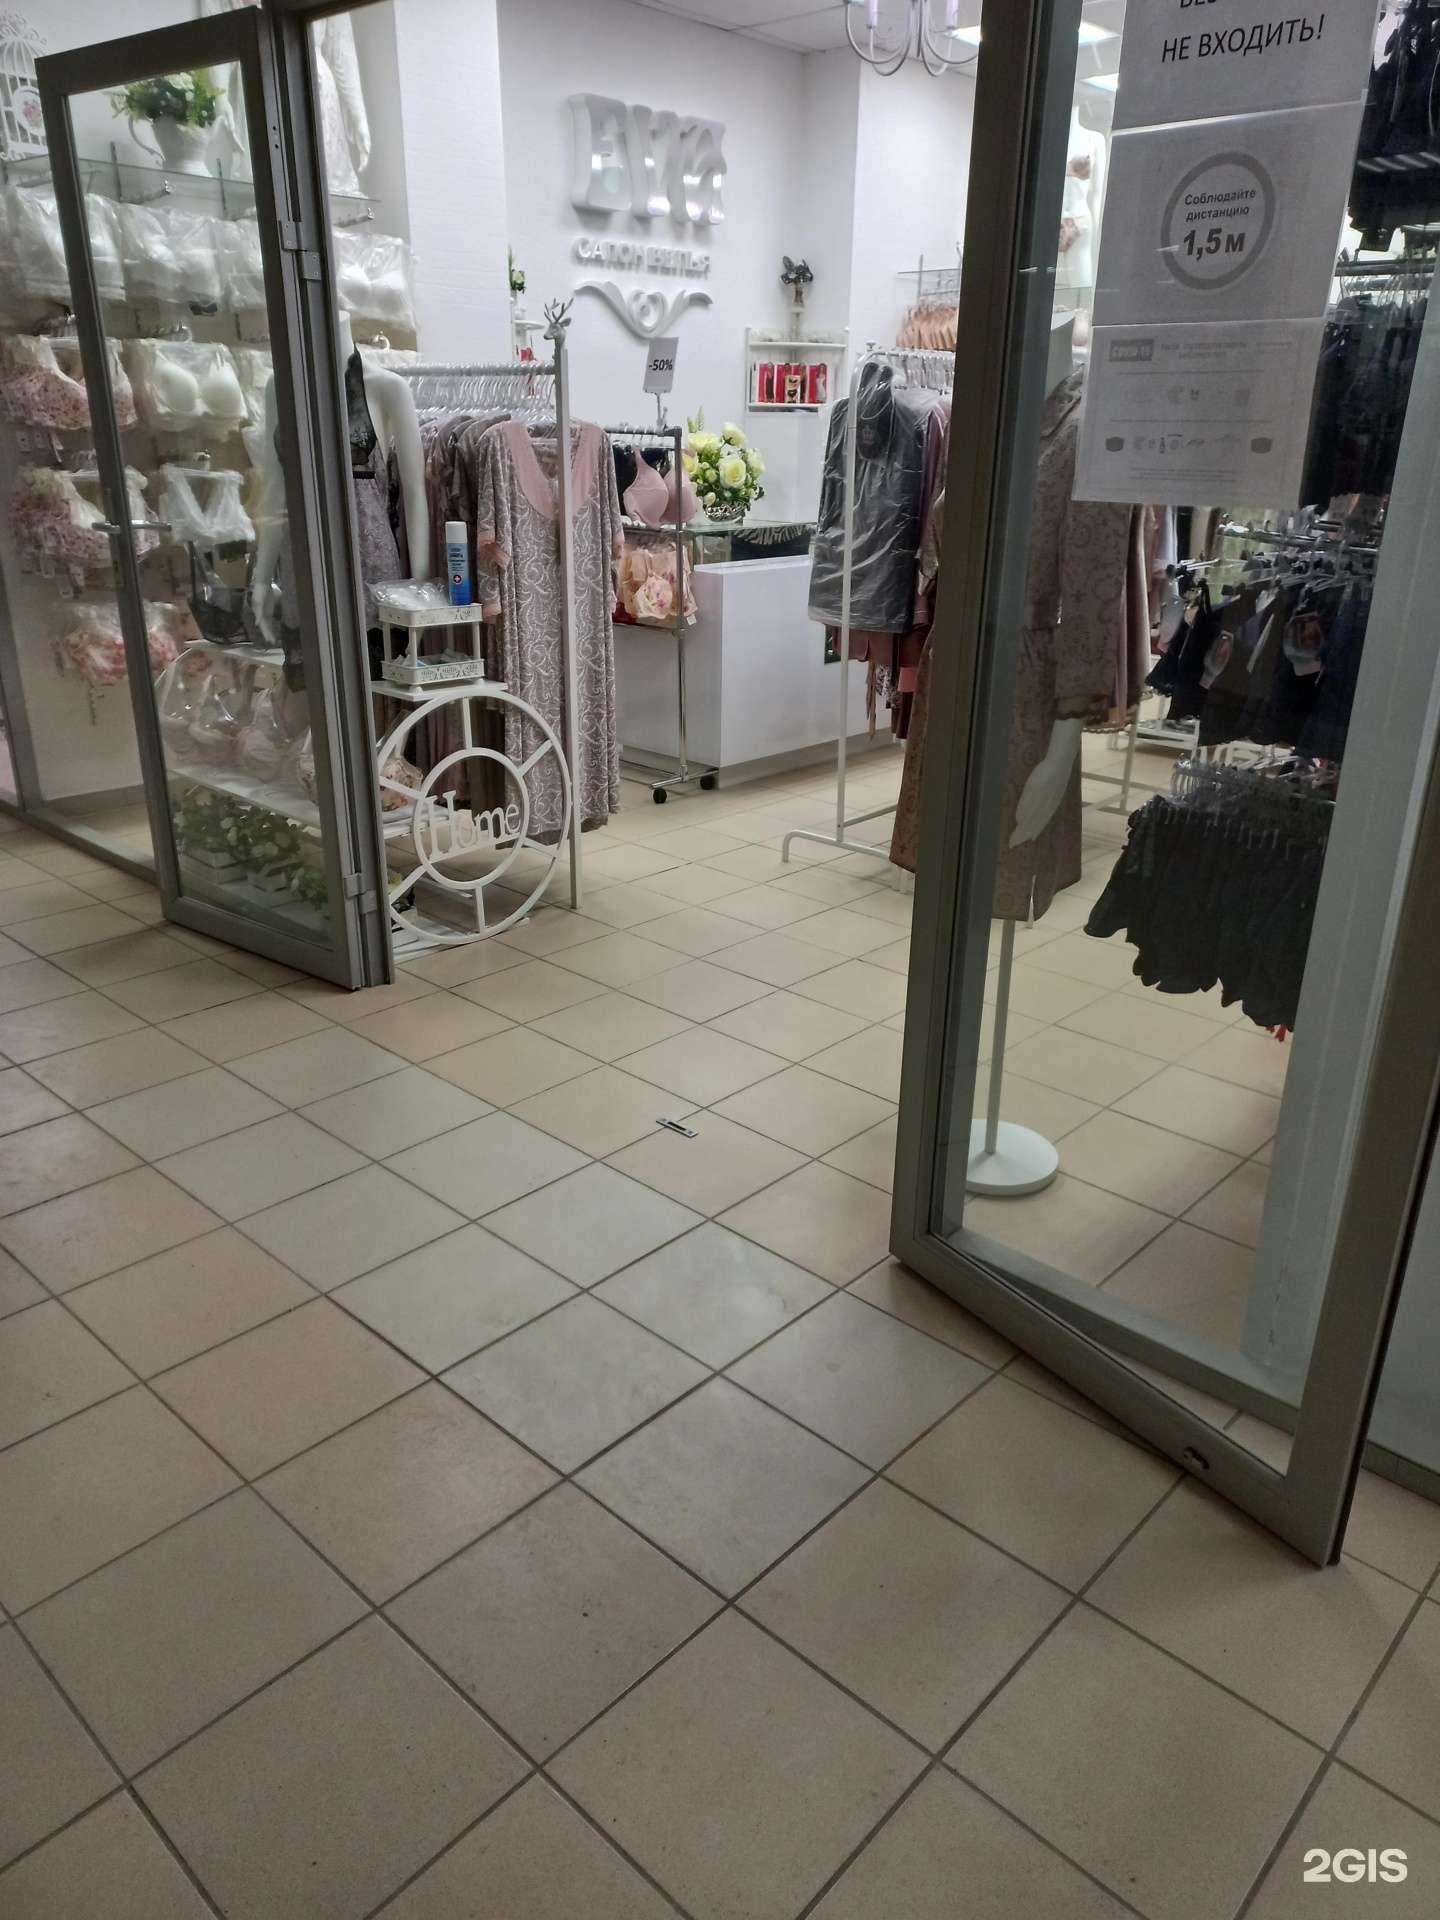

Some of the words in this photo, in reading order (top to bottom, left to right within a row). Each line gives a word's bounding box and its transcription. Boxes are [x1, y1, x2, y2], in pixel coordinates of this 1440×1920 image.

[1161, 36, 1192, 62] НЕ
[1198, 14, 1326, 57] ВХОДИТЬ!
[1184, 189, 1256, 206] Соблюдайте
[1185, 206, 1250, 223] дистанцию
[1183, 228, 1222, 261] 1,5
[648, 359, 673, 371] -50%
[424, 790, 521, 860] Home
